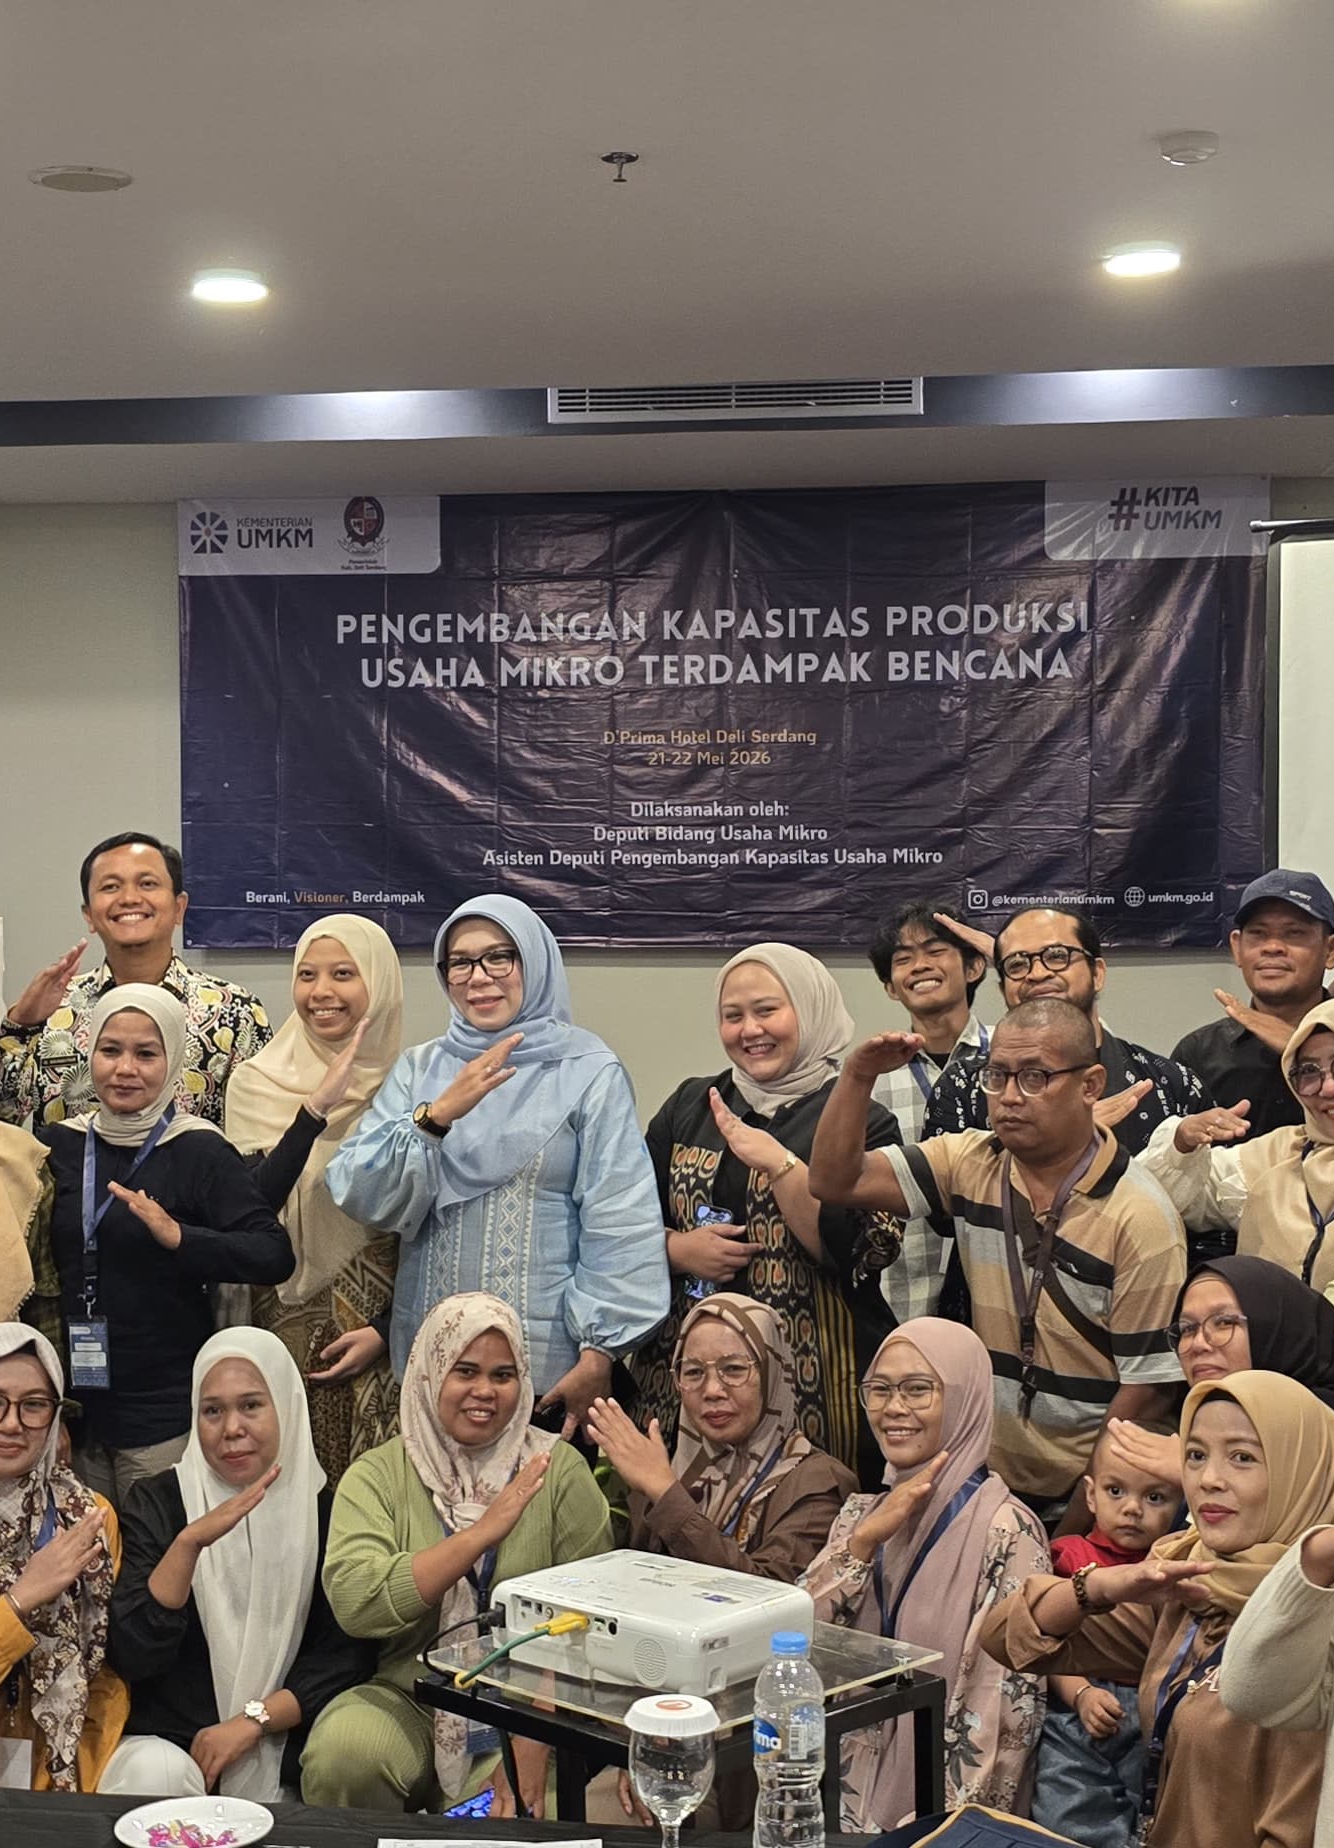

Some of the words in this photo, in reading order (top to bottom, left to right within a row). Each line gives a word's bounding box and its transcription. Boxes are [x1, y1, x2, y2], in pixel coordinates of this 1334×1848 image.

[236, 517, 313, 528] KEMENTERIAN
[1144, 510, 1222, 530] UMKM
[237, 528, 314, 549] UMKM
[337, 610, 647, 644] PENGEMBANGAN
[663, 606, 870, 641] KAPASITAS
[886, 602, 1089, 636] PRODUKSI
[361, 656, 486, 688] USAHA
[500, 655, 625, 688] MIKRO
[639, 652, 872, 685] TERDAMPAK
[887, 648, 1073, 682] BENCANA
[603, 730, 665, 745] D'Prima
[671, 730, 711, 744] Hotel
[717, 729, 746, 744] Deli
[751, 729, 817, 746] Serdang
[648, 751, 692, 766] 21-22
[697, 751, 725, 765] Mei
[729, 750, 771, 765] 2026
[631, 801, 743, 817] Dilaksanakan
[749, 801, 790, 816] oleh:
[593, 826, 649, 845] Deputi
[655, 825, 716, 845] Bidang
[720, 825, 773, 841] Usaha
[779, 825, 828, 841] Mikro
[482, 850, 544, 866] Asisten
[549, 850, 605, 868] Deputi
[610, 849, 740, 868] Pengembangan
[745, 849, 829, 868] Kapasitas
[834, 848, 887, 864] Usaha
[893, 848, 943, 864] Mikro
[246, 891, 291, 904] Berani,
[293, 891, 349, 904] Visioner,
[352, 891, 425, 905] Berdampak
[991, 894, 1115, 906] @kementerianumkm
[1148, 892, 1214, 904] umkm.go.id
